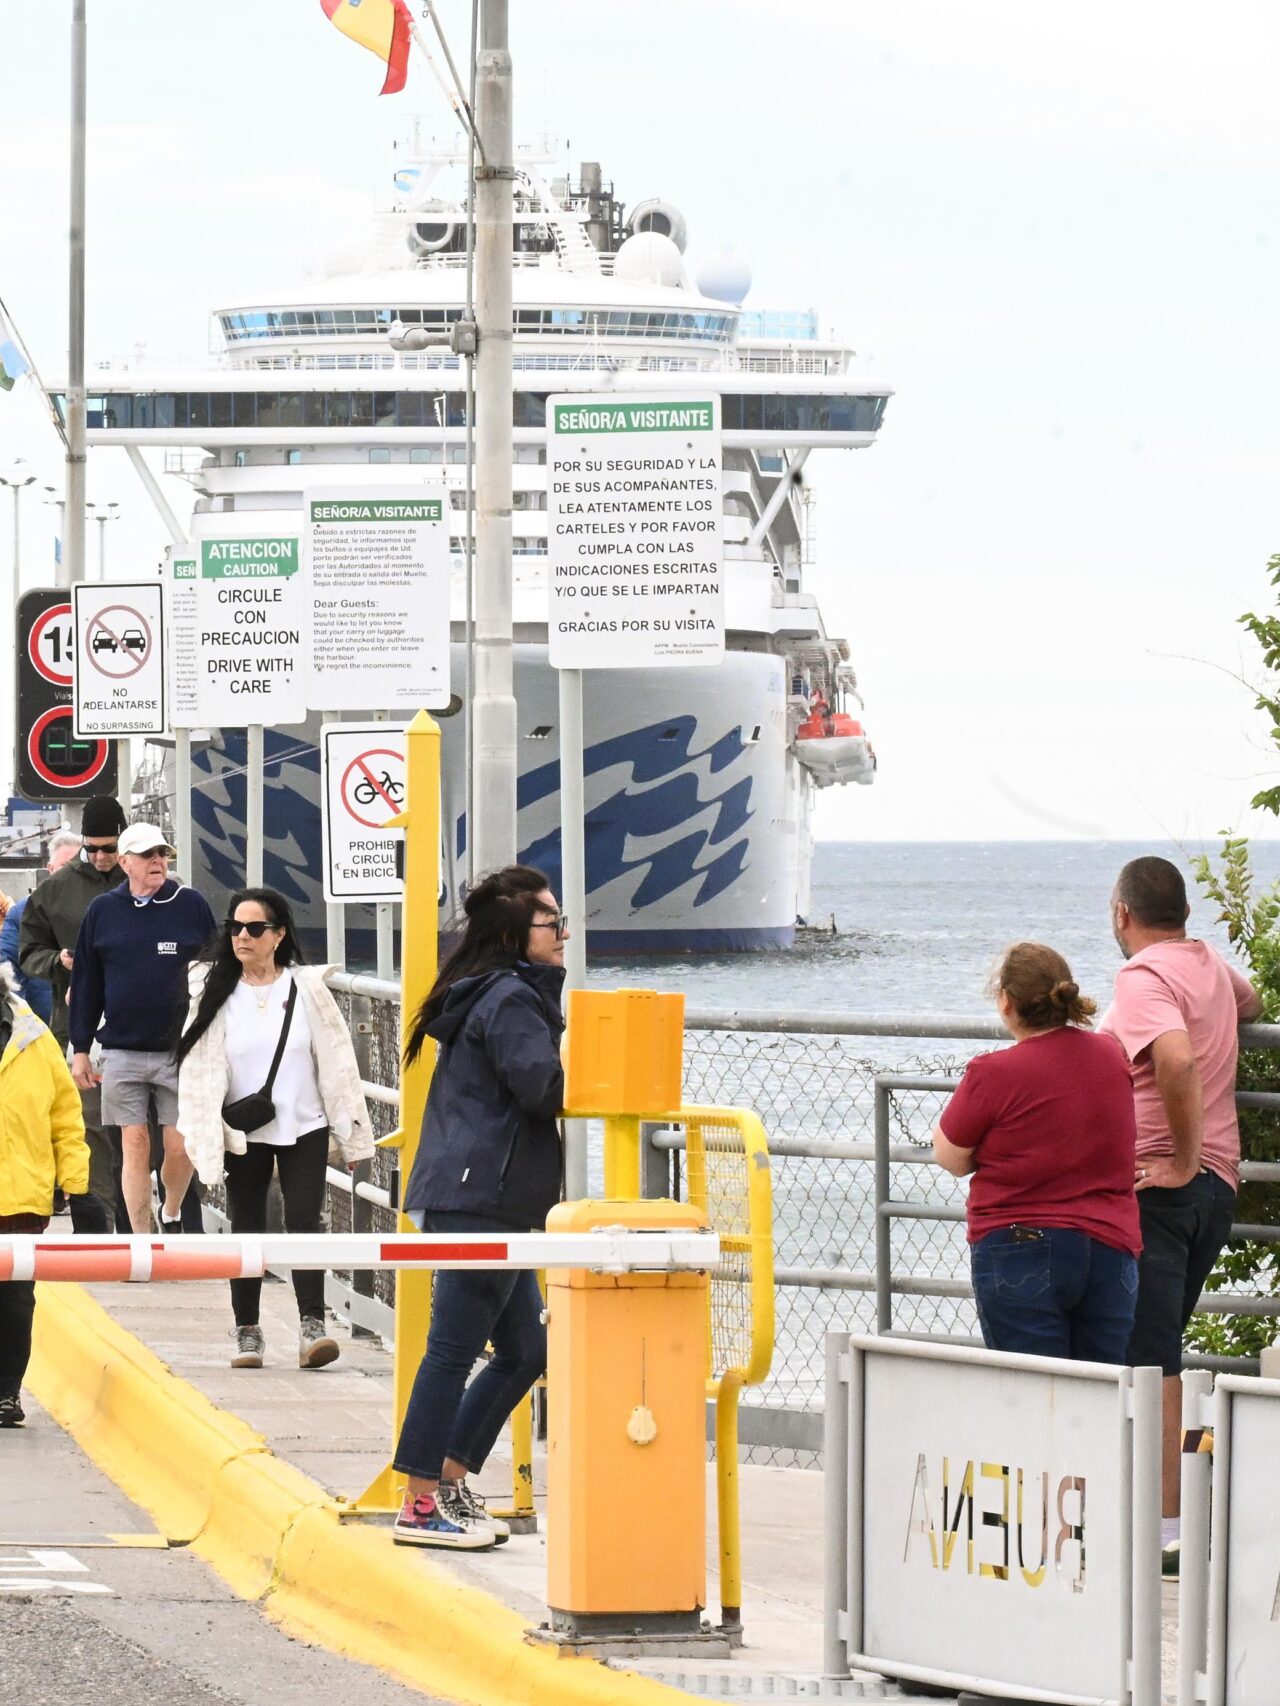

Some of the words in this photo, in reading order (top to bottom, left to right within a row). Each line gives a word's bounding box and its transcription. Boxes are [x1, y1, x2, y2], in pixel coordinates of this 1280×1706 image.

[560, 409, 626, 430] SEÑOR/A
[630, 410, 708, 427] VISITANTE
[554, 462, 580, 472] POR
[586, 461, 602, 471] SU
[607, 459, 684, 470] SEGURIDAD
[688, 459, 695, 469] Y
[700, 458, 716, 468] LA
[554, 482, 570, 492] DE
[576, 482, 600, 492] SUS
[604, 478, 716, 492] ACOMPAÑANTES,
[314, 505, 371, 518] SEÑOR/A
[374, 506, 438, 517] VISITANTE
[559, 504, 585, 514] LEA
[587, 501, 682, 512] ATENTAMENTE
[686, 500, 712, 510] LOS
[556, 523, 625, 534] CARTELES
[629, 523, 636, 532] Y
[641, 522, 668, 532] POR
[672, 521, 716, 532] FAVOR
[208, 542, 292, 559] ATENCION
[578, 544, 632, 554] CUMPLA
[637, 543, 664, 553] CON
[670, 542, 694, 552] LAS
[176, 563, 196, 577] SEÑ
[223, 563, 278, 576] CAUTION
[556, 564, 649, 576] INDICACIONES
[654, 563, 717, 574] ESCRITAS
[218, 589, 282, 603] CIRCULE
[555, 586, 576, 596] Y/O
[581, 586, 607, 596] QUE
[612, 586, 628, 596] SE
[633, 586, 648, 595] LE
[654, 584, 718, 595] IMPARTAN
[314, 600, 338, 608] Dear
[341, 599, 379, 608] Guests:
[234, 610, 266, 624] CON
[559, 622, 617, 632] GRACIAS
[622, 621, 648, 631] POR
[654, 620, 670, 630] SU
[675, 620, 715, 630] VISITA
[44, 626, 73, 662] 1
[202, 631, 300, 646] PRECAUCION
[208, 659, 252, 672] DRIVE
[256, 658, 294, 672] WITH
[112, 688, 128, 697] NO
[230, 680, 272, 694] CARE
[54, 691, 73, 700] Vials
[83, 700, 158, 710] ADELANTARSE
[100, 721, 154, 730] SURPASSING
[343, 868, 358, 878] EN
